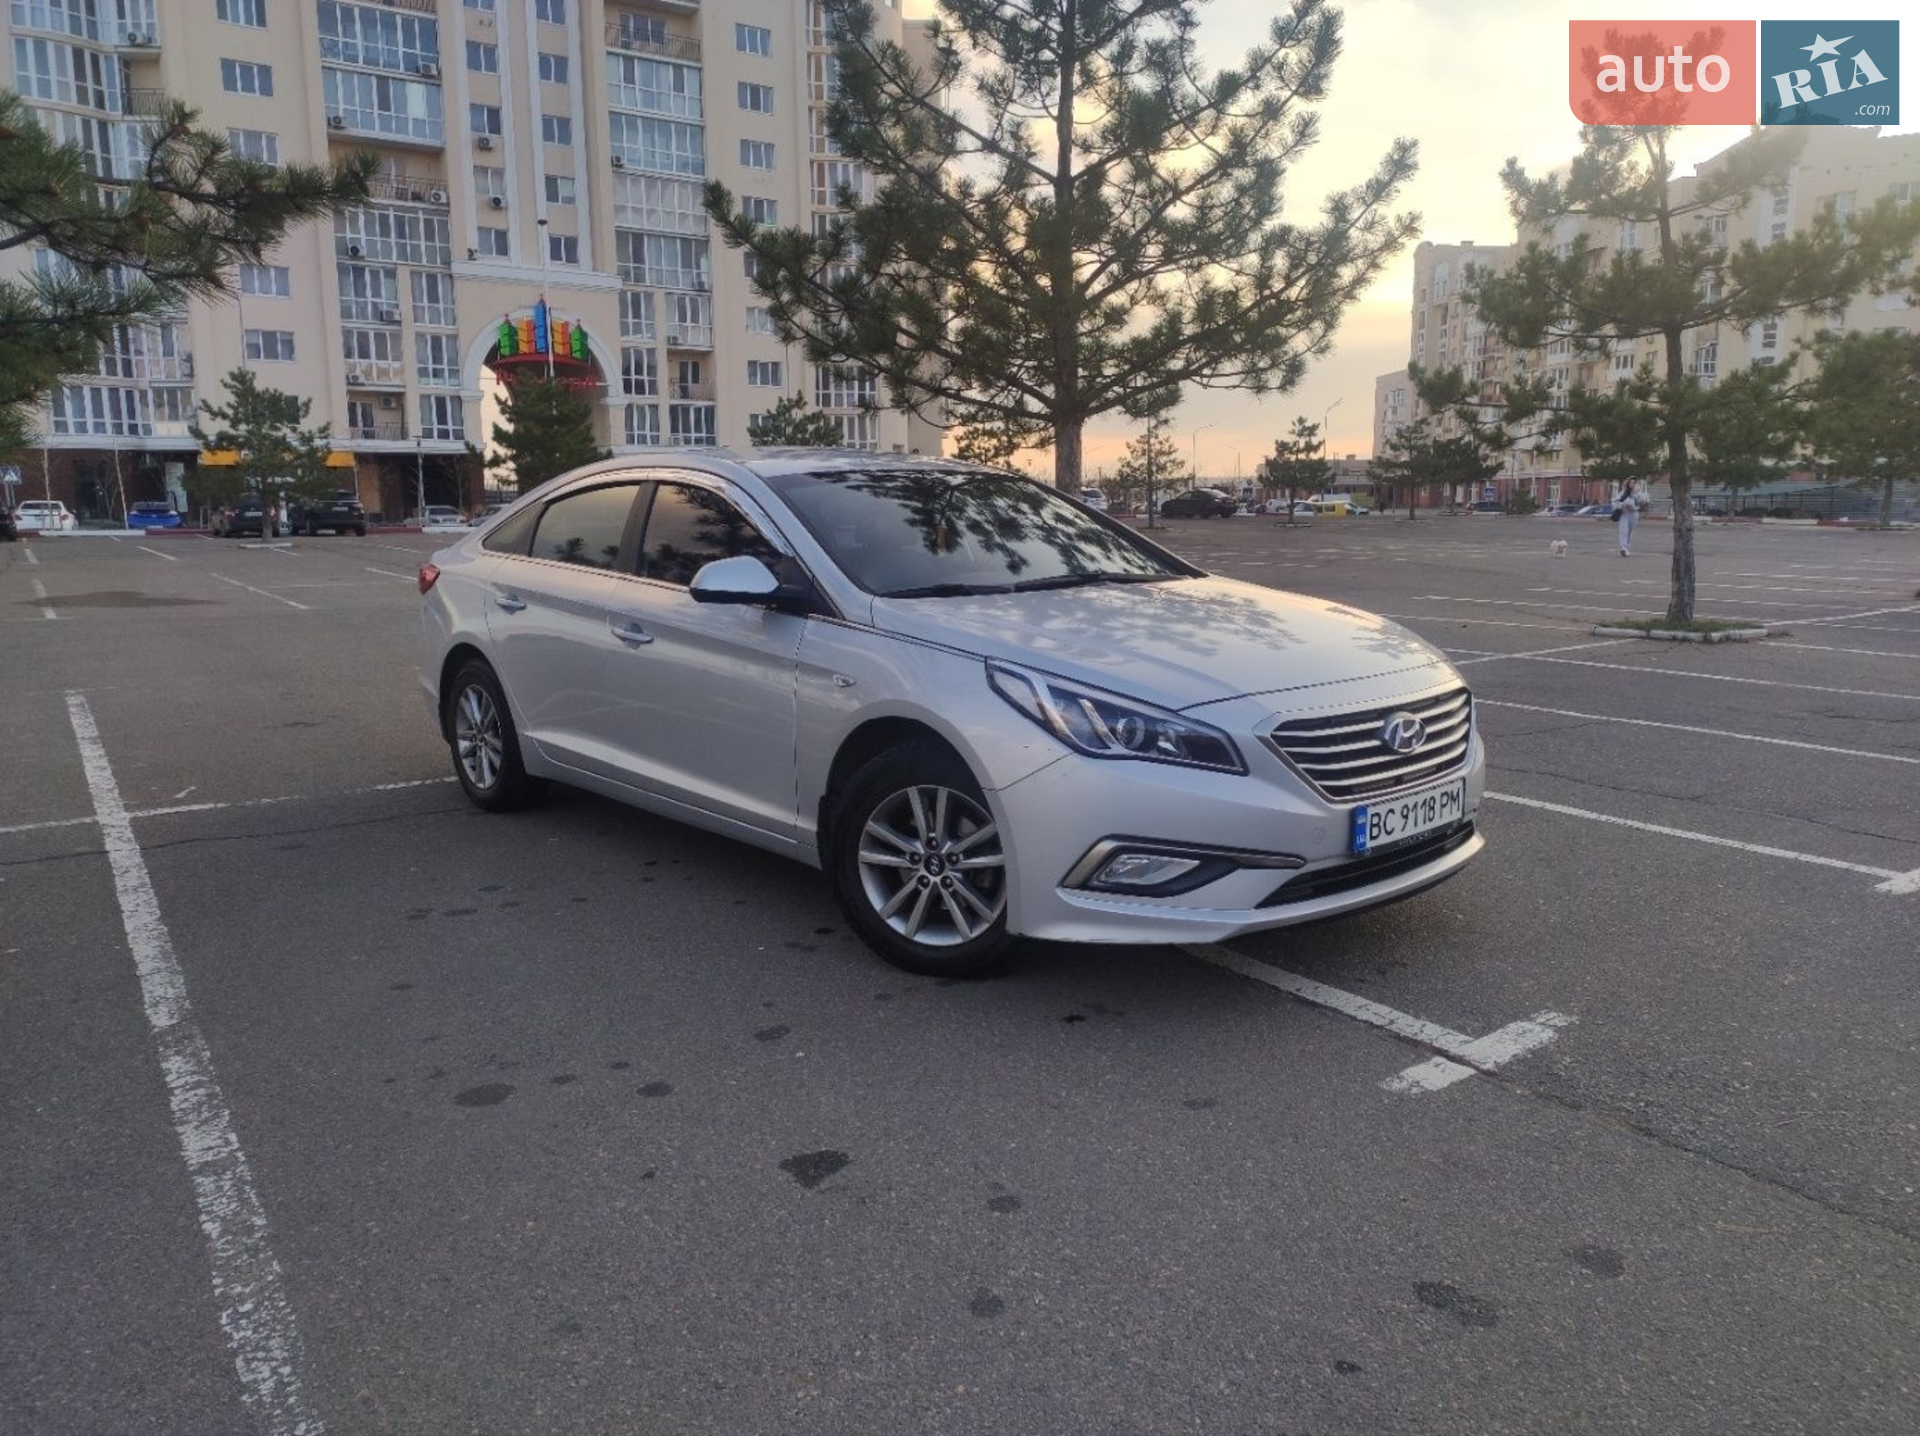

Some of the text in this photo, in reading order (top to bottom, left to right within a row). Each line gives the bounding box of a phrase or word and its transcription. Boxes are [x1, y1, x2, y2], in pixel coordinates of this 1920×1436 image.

[1370, 808, 1396, 841] BC
[1400, 796, 1437, 832] 9118
[1440, 788, 1461, 819] PM
